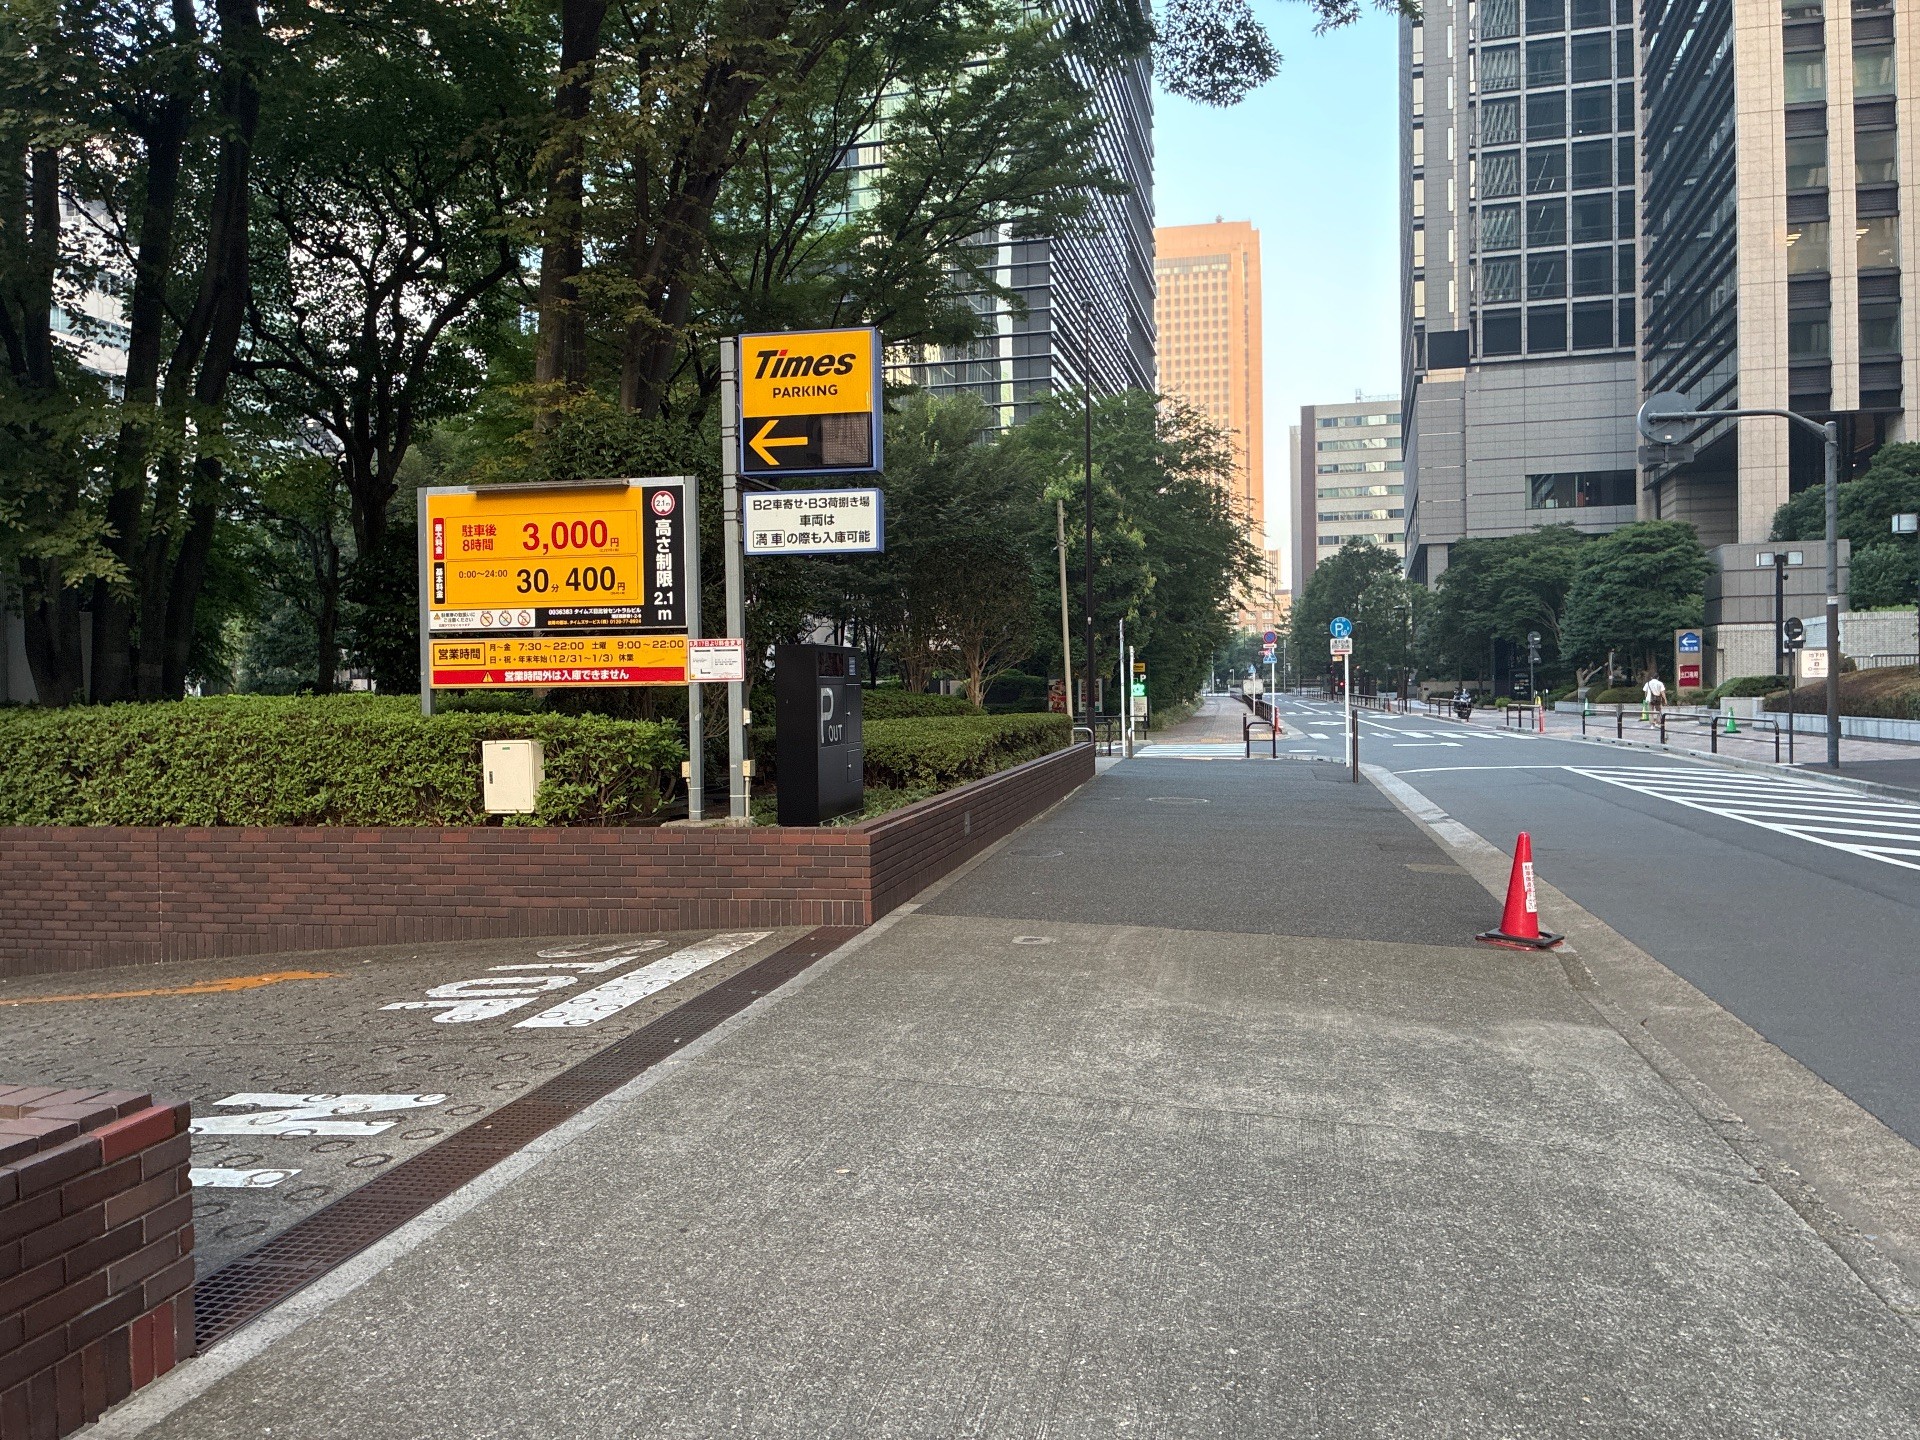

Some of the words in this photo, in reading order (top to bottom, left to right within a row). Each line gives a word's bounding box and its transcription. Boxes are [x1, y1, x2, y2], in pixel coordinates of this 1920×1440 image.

[755, 349, 857, 379] Times
[772, 384, 838, 399] PARKING
[799, 514, 835, 527] 車両は
[462, 524, 497, 537] 駐車後
[435, 524, 443, 555] 最大料金
[462, 539, 494, 552] 8時間
[435, 567, 444, 599] 基本料金
[1335, 623, 1344, 637] P
[592, 641, 607, 650] 土曜
[438, 647, 481, 661] 営業時間
[618, 653, 634, 662] 休業
[504, 669, 630, 682] 営業時間外は入庫できません
[1140, 674, 1147, 682] P
[820, 687, 834, 744] P
[828, 724, 843, 743] OUT
